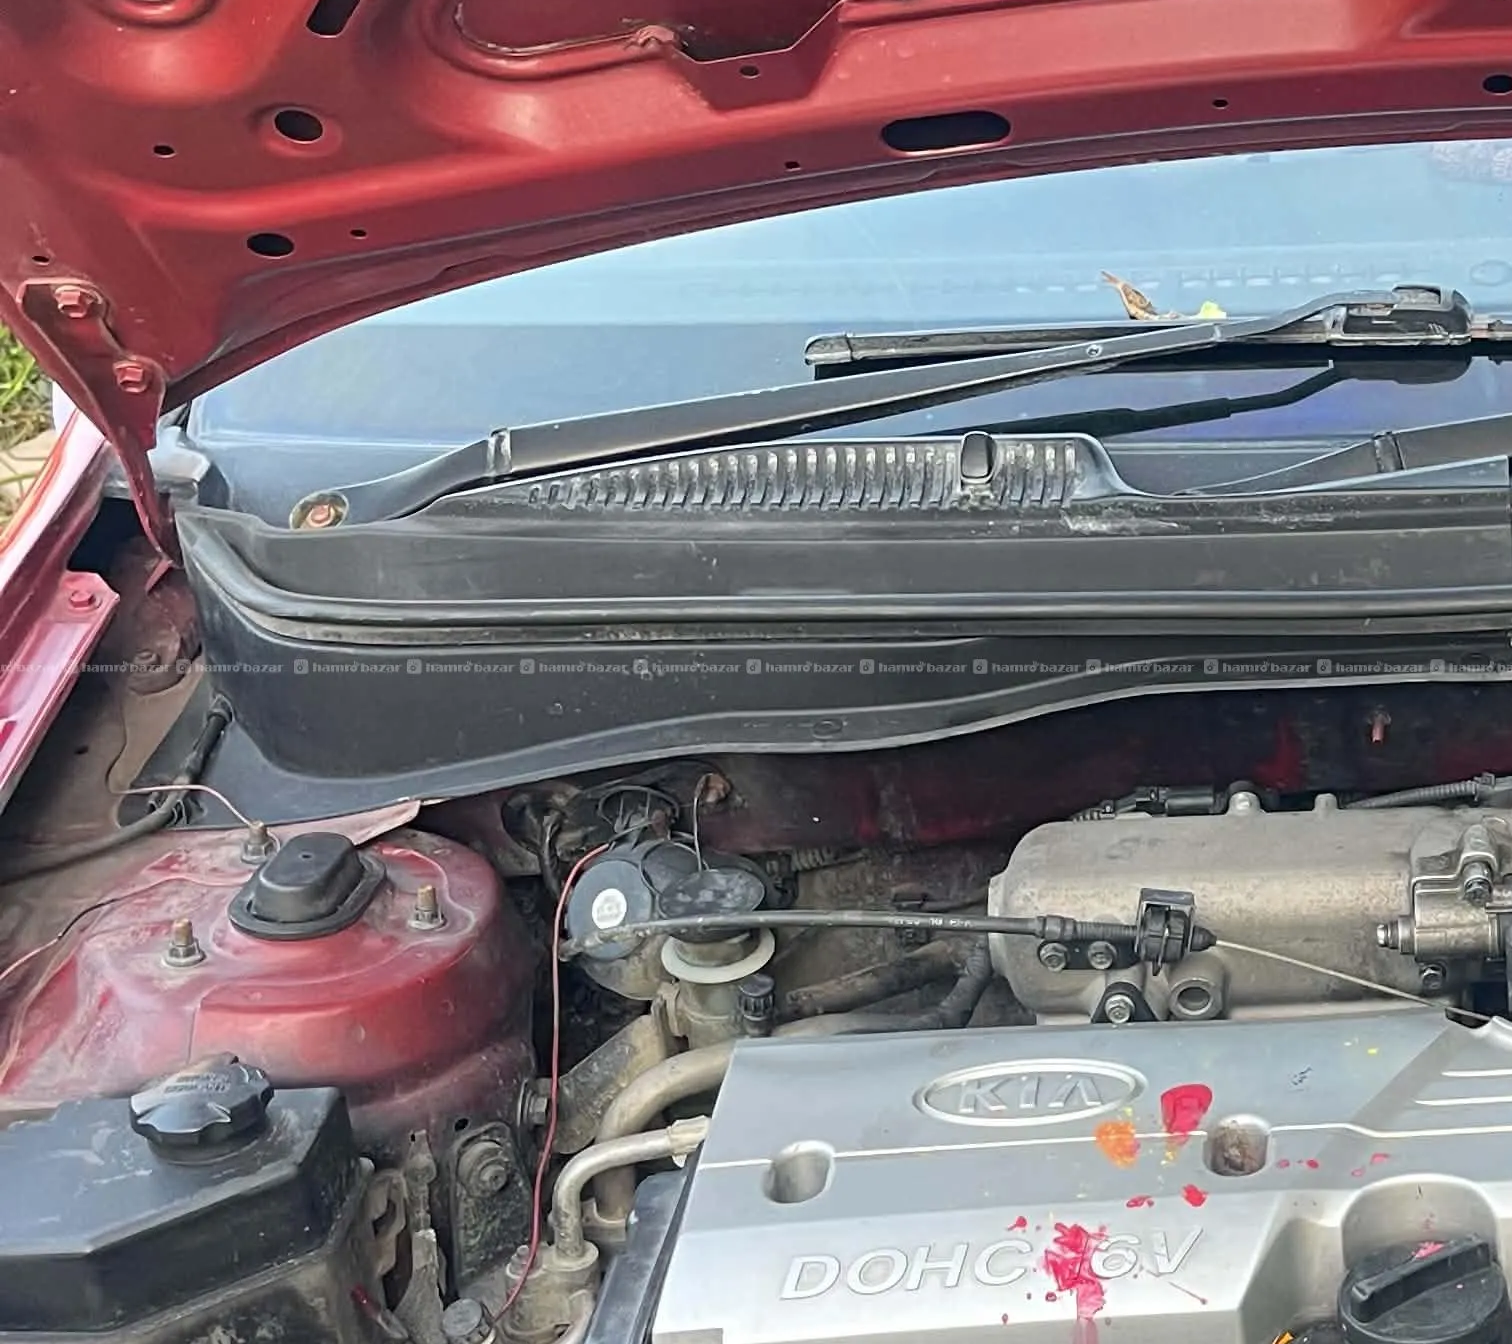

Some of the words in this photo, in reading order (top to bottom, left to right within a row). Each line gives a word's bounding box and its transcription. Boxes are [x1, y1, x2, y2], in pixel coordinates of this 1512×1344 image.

[957, 1073, 1101, 1115] KIA
[779, 1239, 1033, 1301] DOHC
[1078, 1225, 1204, 1280] 6V
